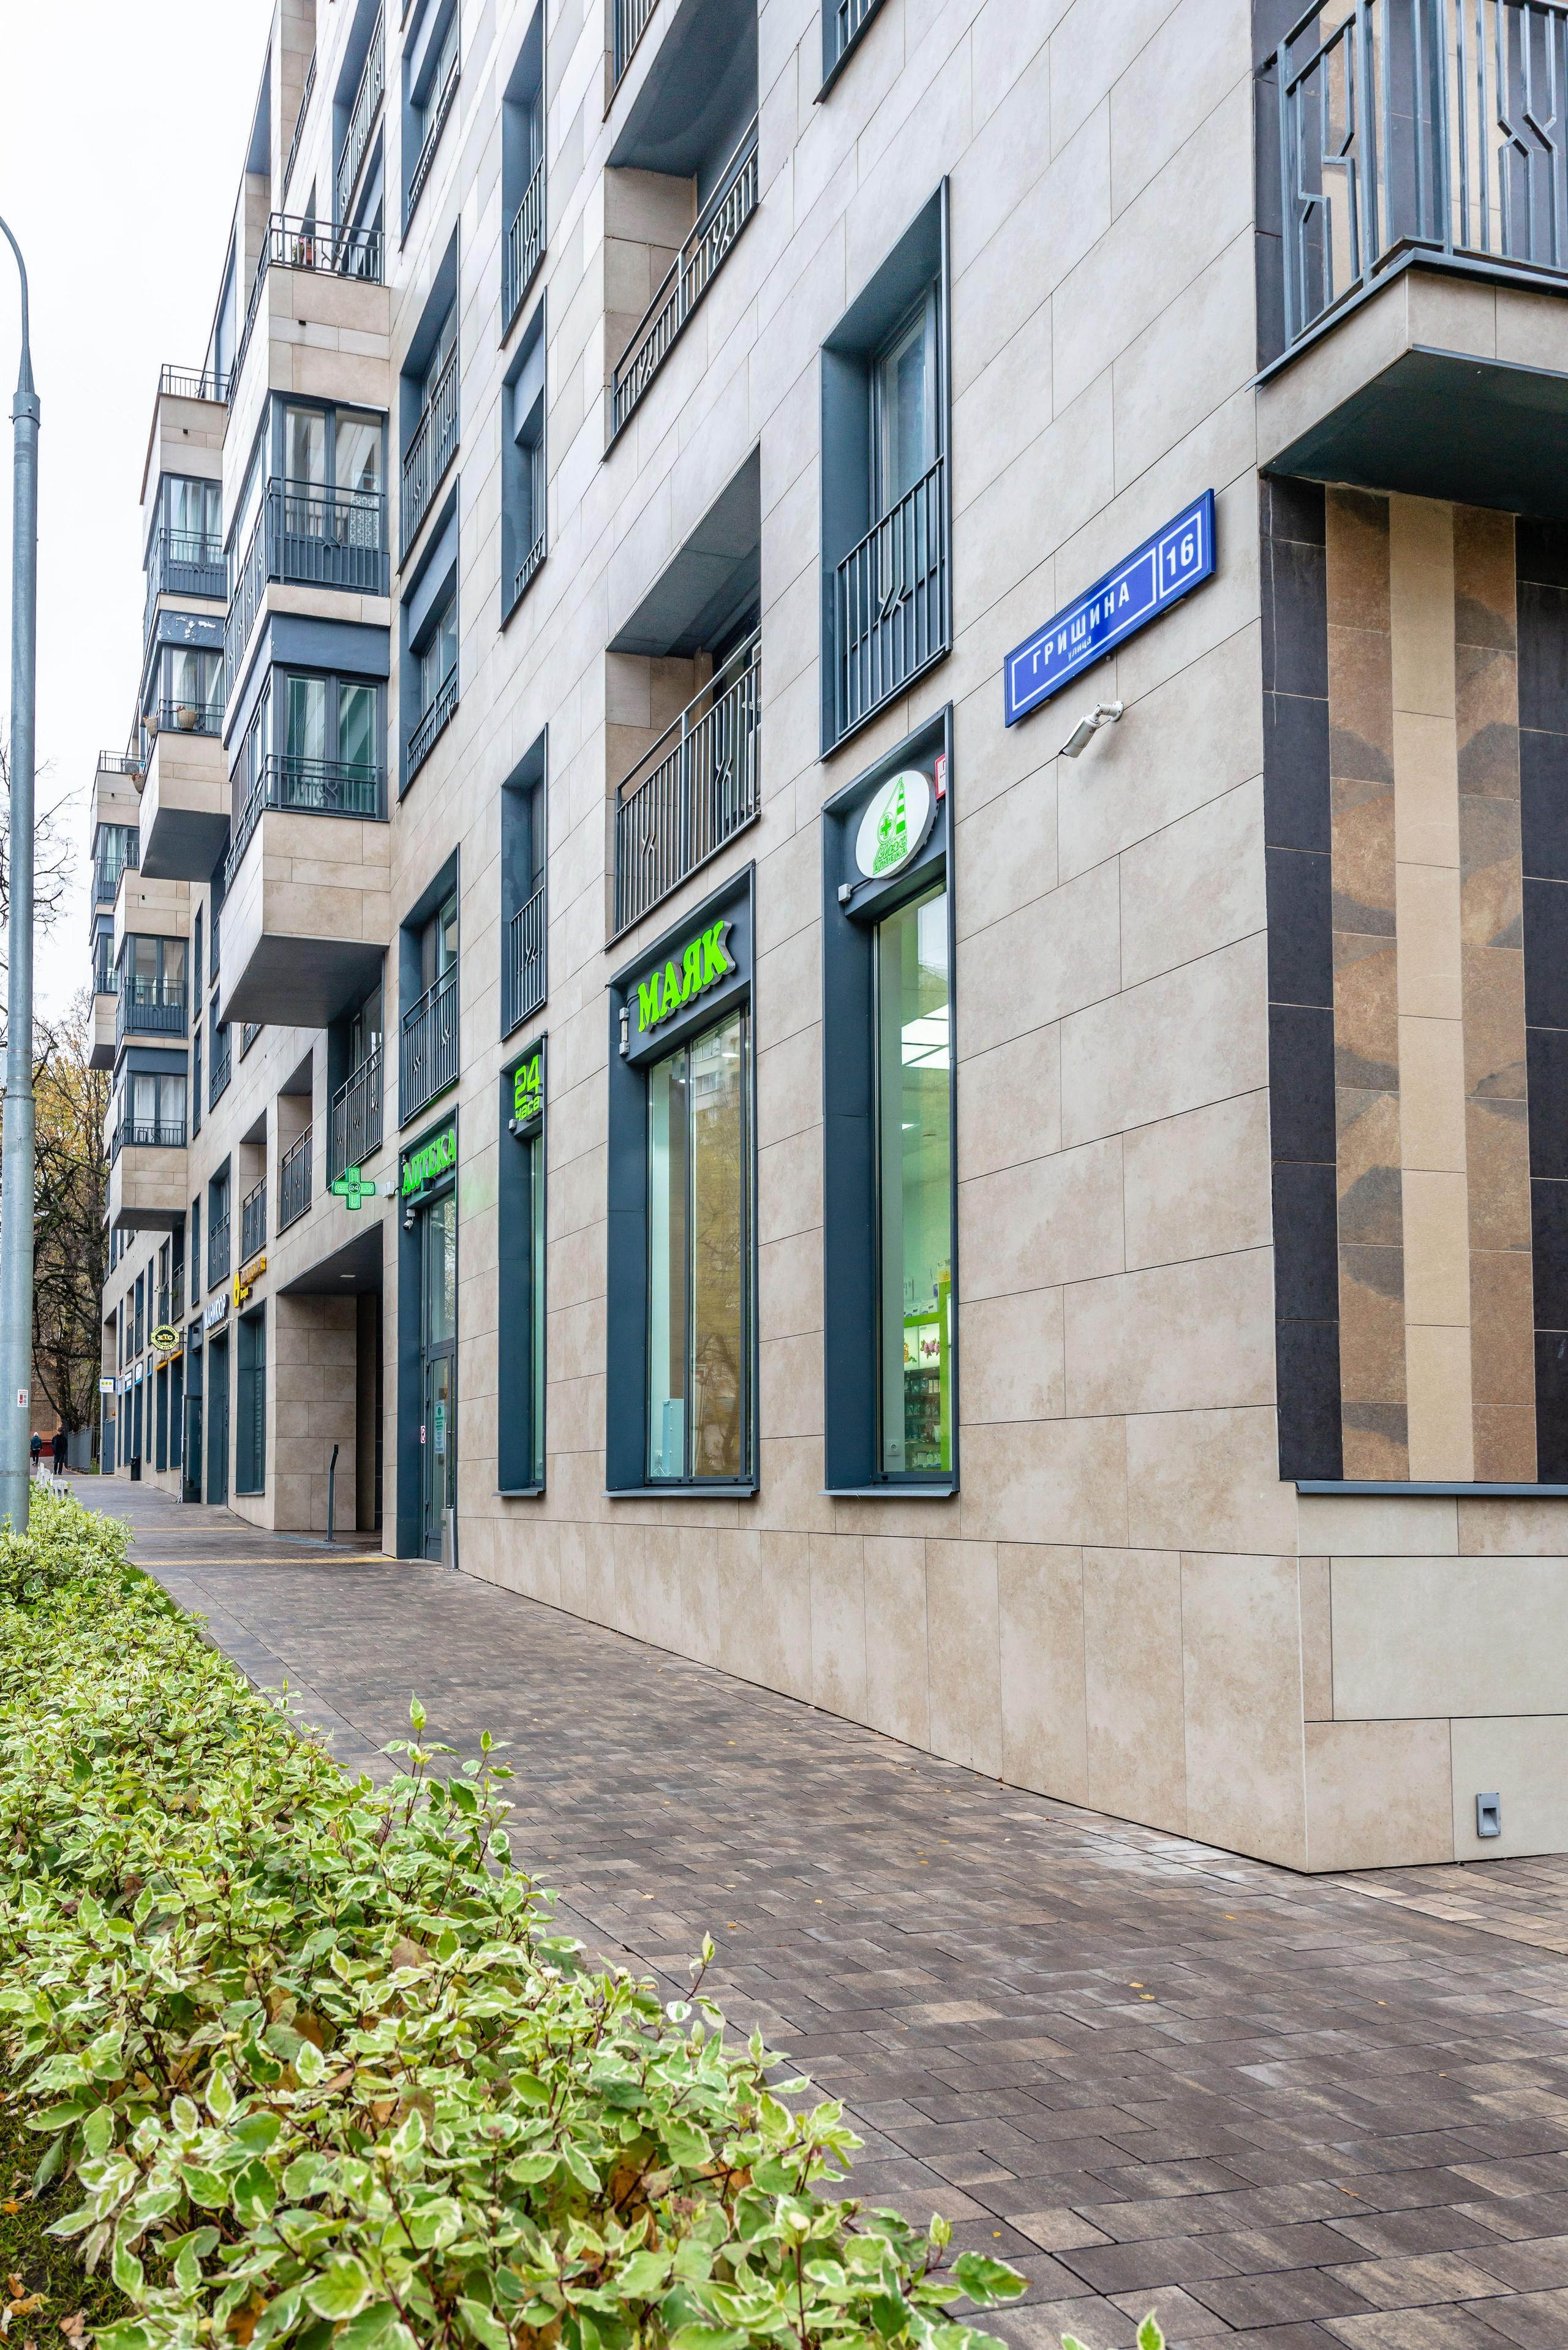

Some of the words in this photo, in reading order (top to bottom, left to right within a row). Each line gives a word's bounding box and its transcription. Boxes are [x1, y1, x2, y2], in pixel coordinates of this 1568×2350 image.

[1033, 581, 1130, 674] ГРИШИНА
[1166, 533, 1194, 576] 16
[1068, 635, 1091, 661] улица
[874, 847, 906, 872] АПТЕКА
[638, 920, 728, 1033] МАЯК
[514, 1054, 540, 1110] 24
[515, 1095, 540, 1121] часа
[402, 1129, 456, 1196] АПТЕКА
